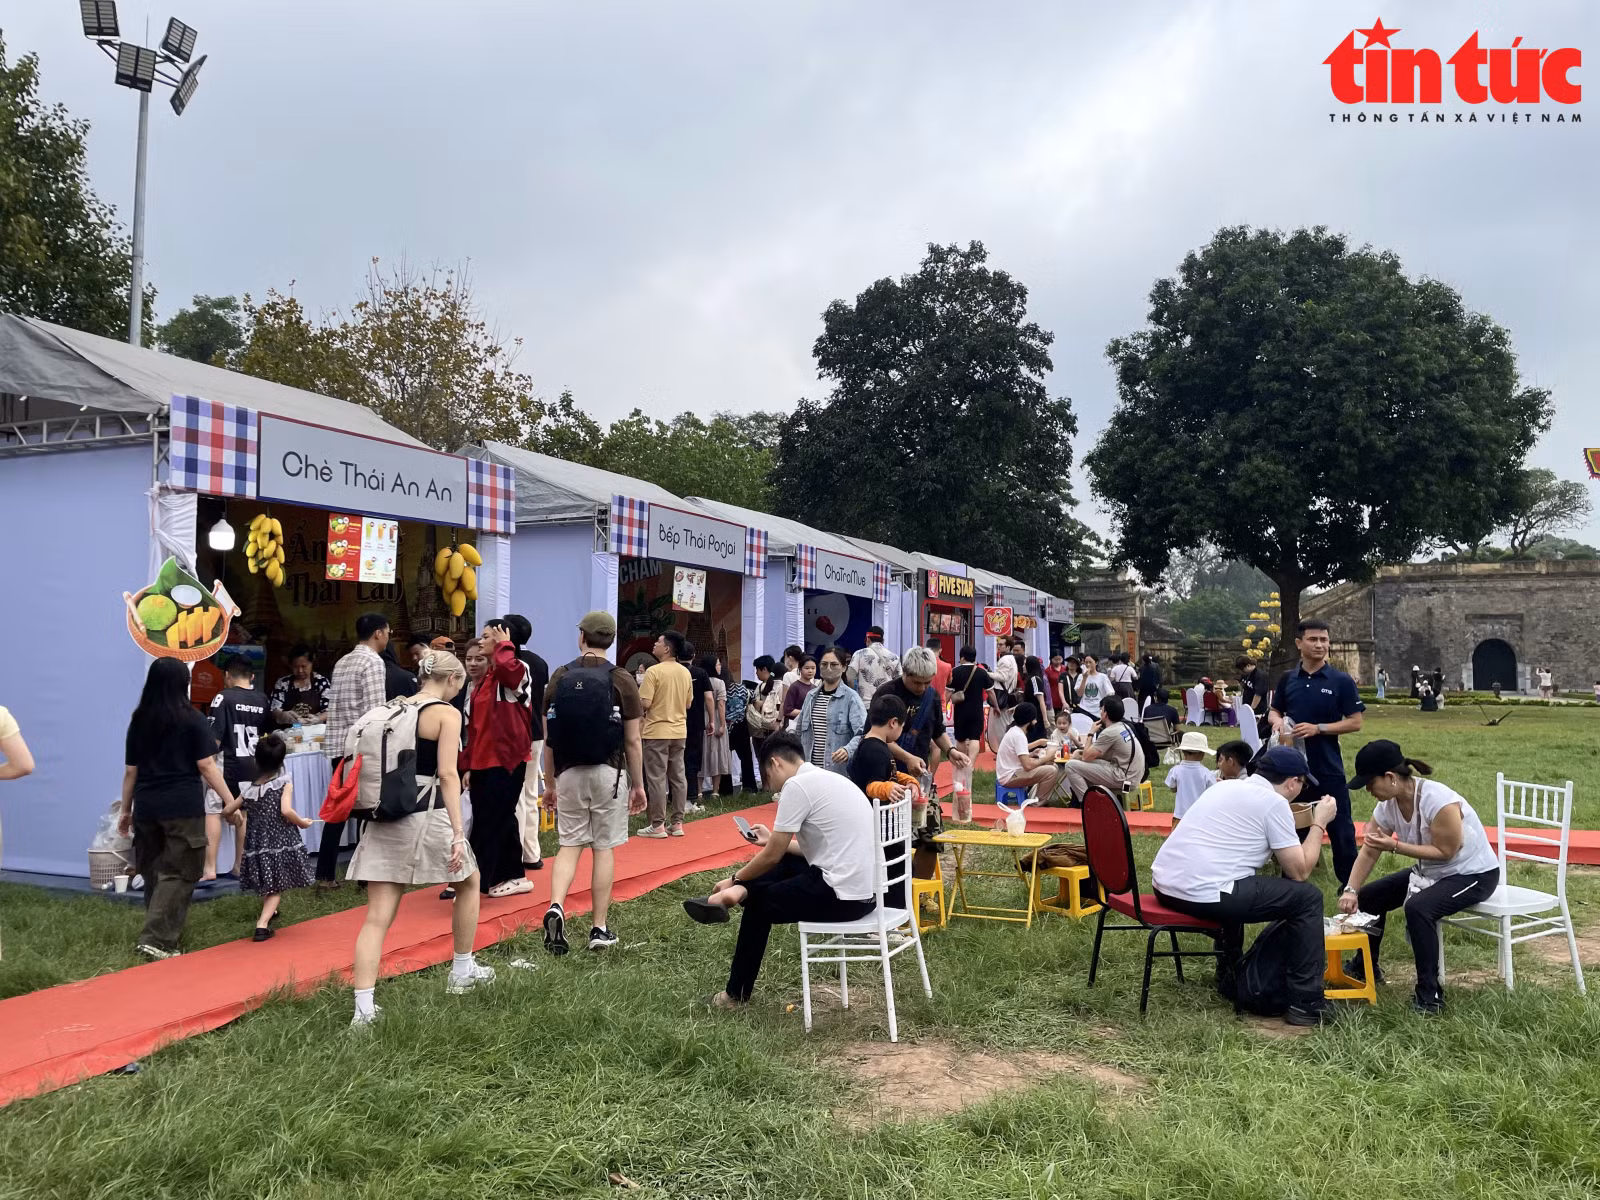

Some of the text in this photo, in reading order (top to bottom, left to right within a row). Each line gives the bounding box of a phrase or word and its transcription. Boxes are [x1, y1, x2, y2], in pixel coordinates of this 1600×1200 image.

[282, 450, 452, 503] Chè Thái An An
[659, 523, 736, 559] Bếp Thái Porjai
[824, 563, 866, 587] ChaTraMue
[938, 574, 974, 598] FIVE STAR
